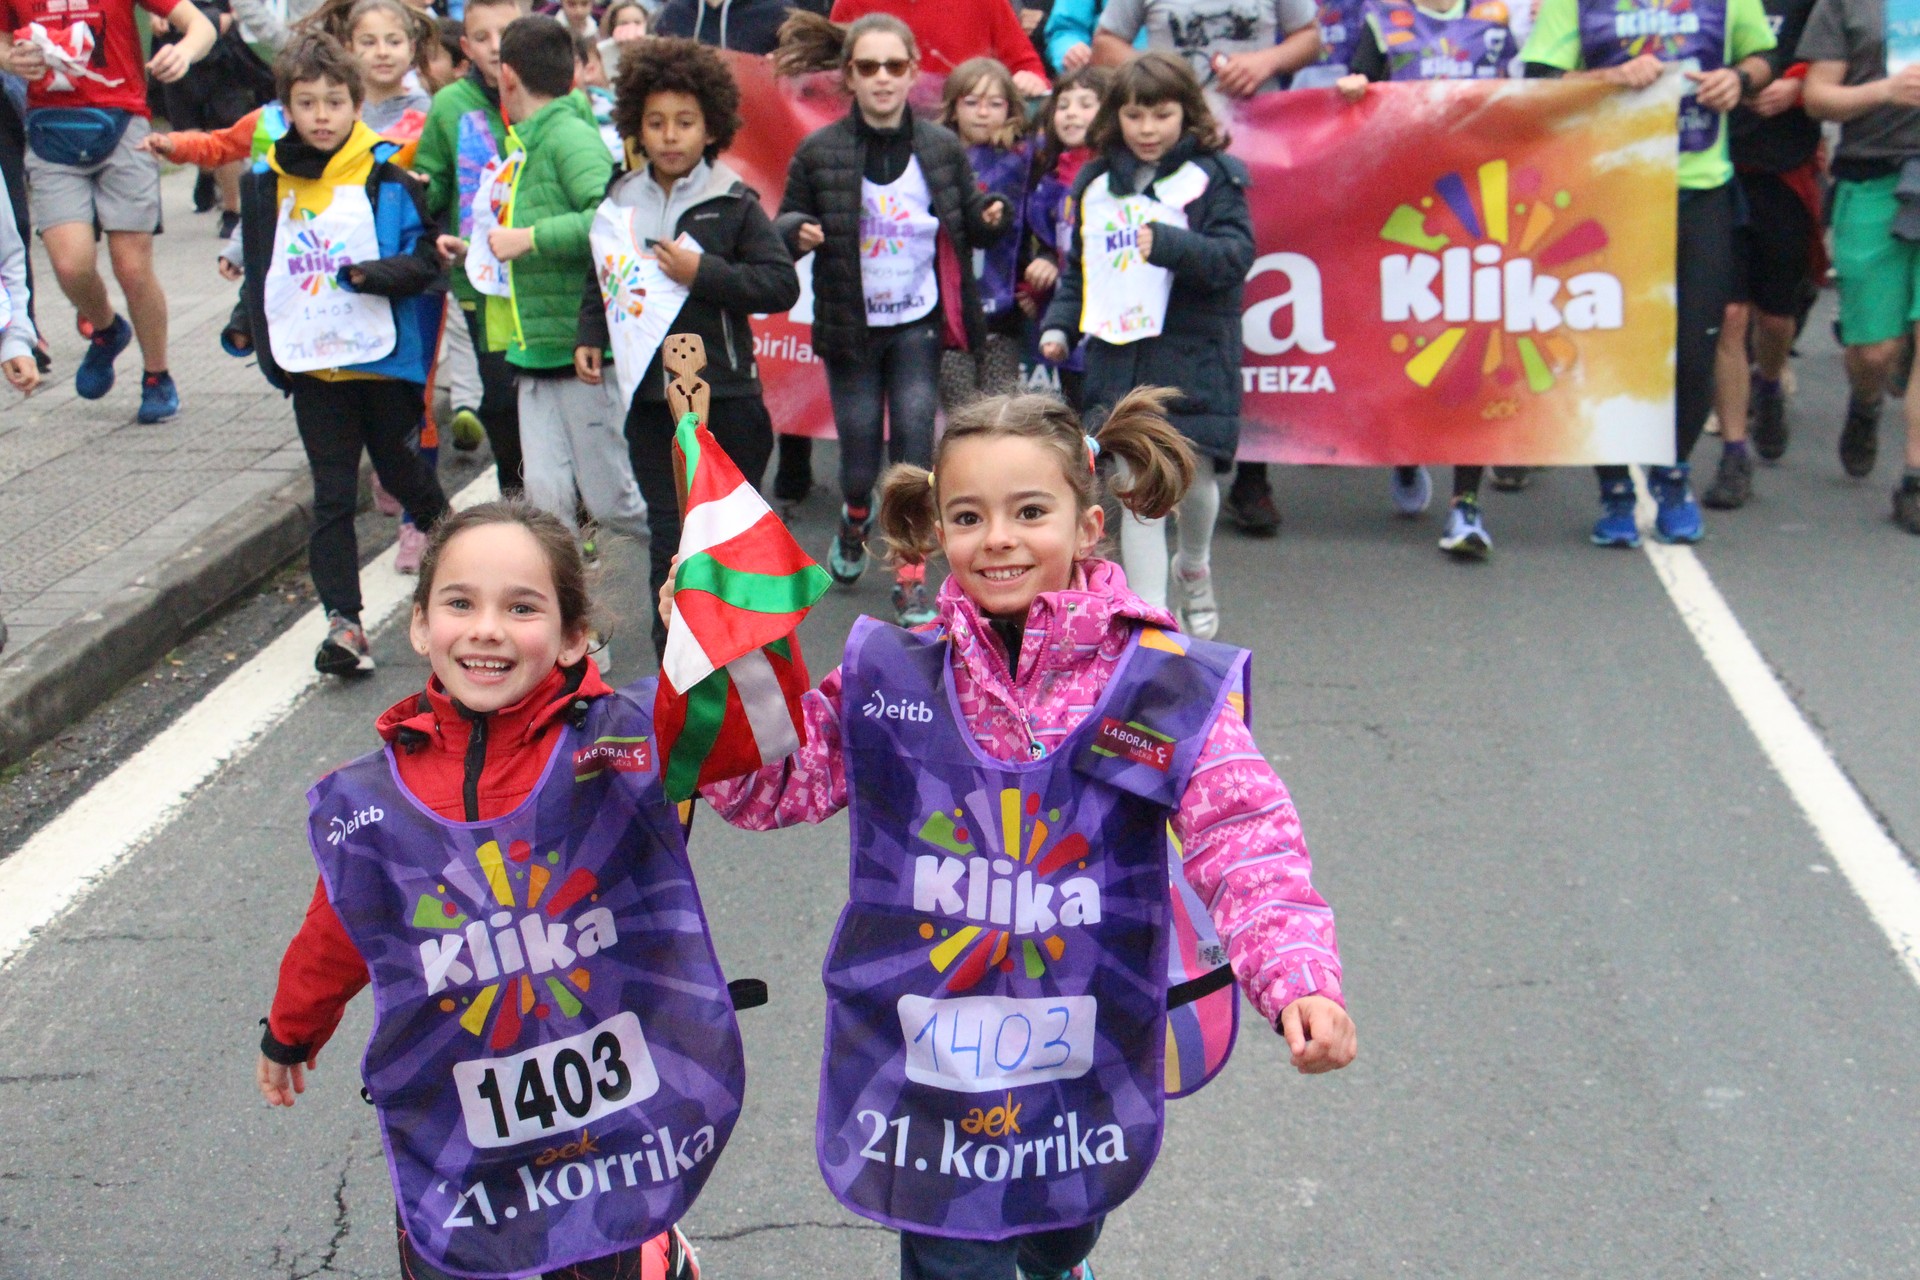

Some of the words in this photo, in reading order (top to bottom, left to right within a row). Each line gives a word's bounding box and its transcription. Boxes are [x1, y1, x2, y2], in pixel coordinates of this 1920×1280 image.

[1380, 244, 1623, 332] Klika
[886, 698, 934, 723] eitb
[1103, 724, 1155, 752] LABORAL
[577, 746, 631, 764] LABORAL
[346, 805, 384, 835] eitb
[913, 855, 1102, 935] Klika
[419, 906, 618, 997] Klika
[913, 1006, 1071, 1077] 1403
[476, 1031, 633, 1138] 1403
[517, 1125, 716, 1212] korrika
[856, 1109, 928, 1172] 21.
[939, 1111, 1129, 1182] korrika
